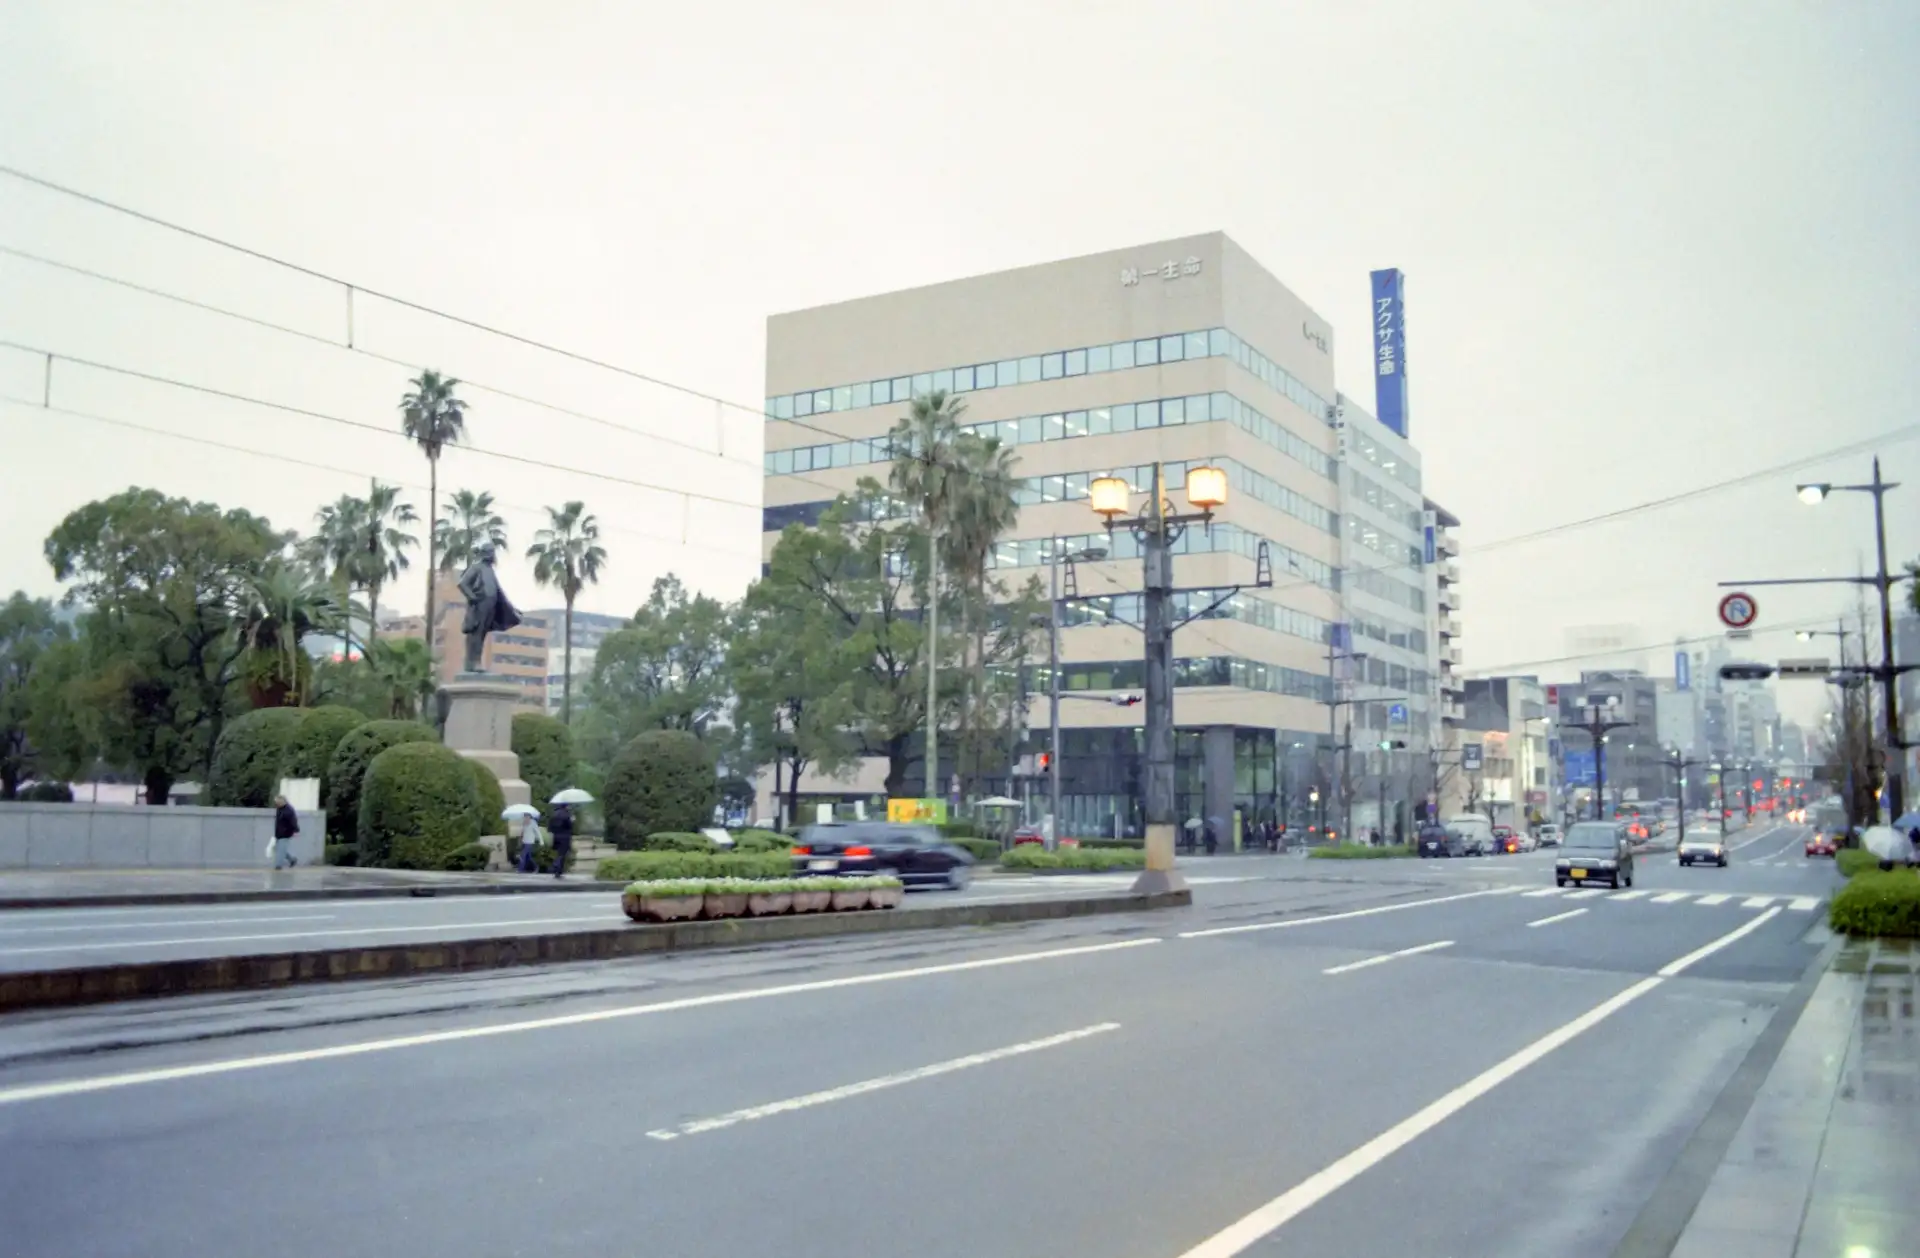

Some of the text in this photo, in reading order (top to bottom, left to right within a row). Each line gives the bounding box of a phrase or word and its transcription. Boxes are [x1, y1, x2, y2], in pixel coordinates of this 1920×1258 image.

[1376, 297, 1395, 375] アクサ生命
